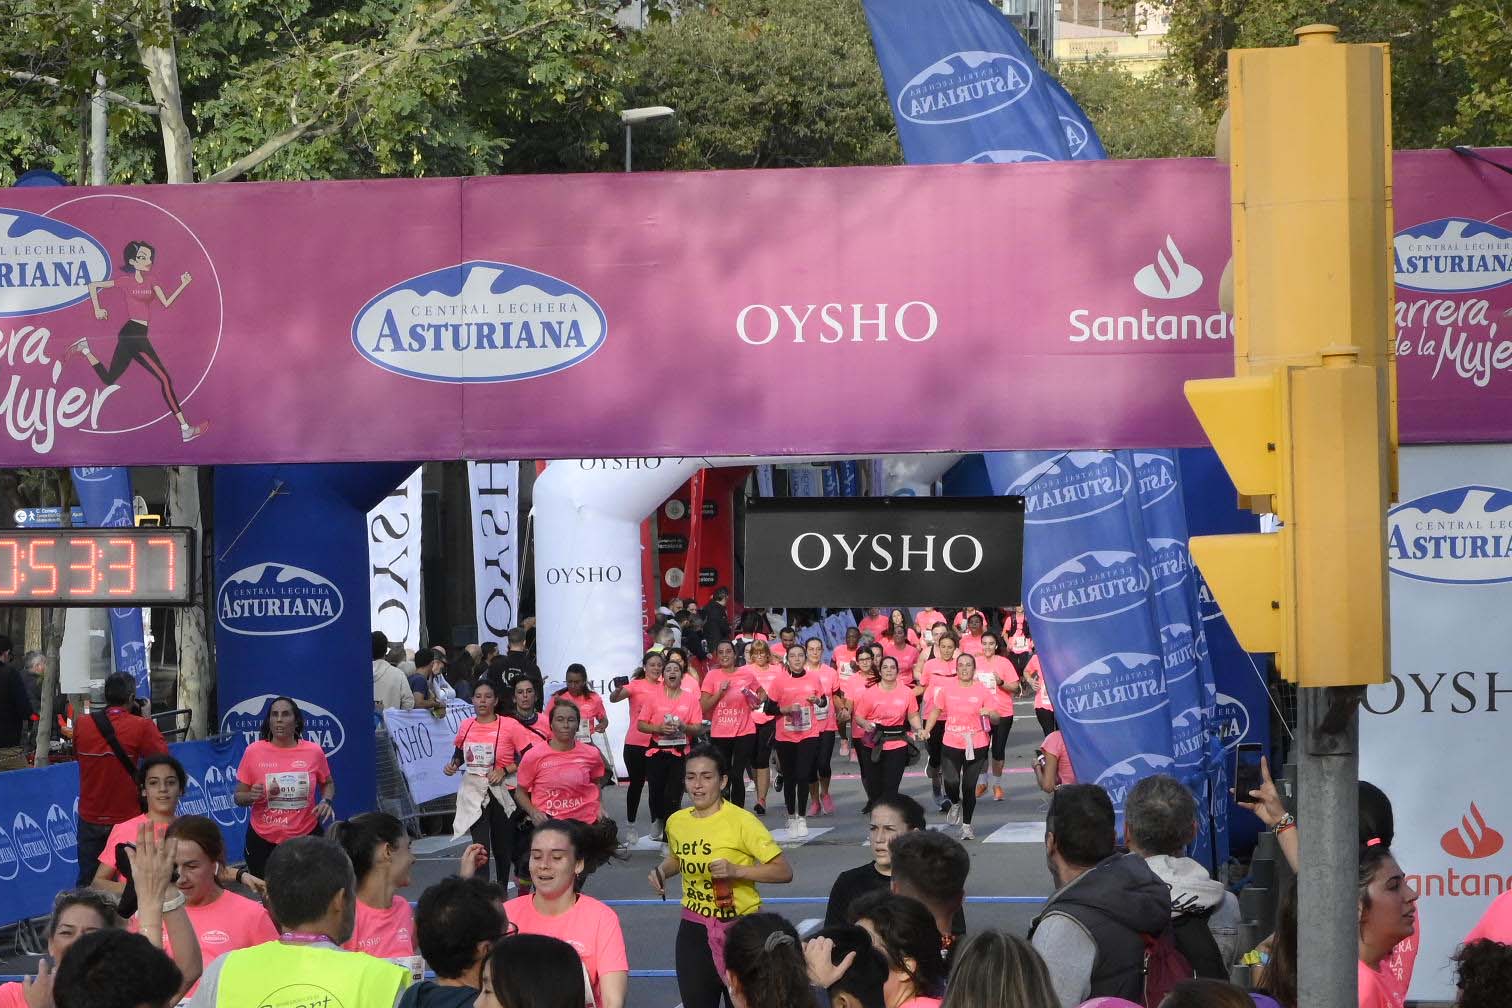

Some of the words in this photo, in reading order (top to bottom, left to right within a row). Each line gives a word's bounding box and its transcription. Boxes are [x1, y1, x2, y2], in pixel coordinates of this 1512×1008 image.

[15, 244, 87, 257] LECHERA
[1408, 242, 1458, 252] CENTRAL
[411, 304, 489, 318] CENTRAL
[498, 301, 579, 315] LECHERA
[1395, 298, 1490, 328] arrera
[372, 307, 588, 354] ASTURIANA
[736, 300, 938, 346] OYSHO
[1418, 327, 1436, 356] la
[1416, 520, 1482, 531] CENTRAL
[790, 532, 983, 574] OYSHO
[546, 565, 622, 585] OYSHO
[234, 586, 276, 596] CENTRAL
[281, 586, 329, 596] LECHERA
[221, 589, 334, 620] ASTURIANA
[675, 838, 712, 856] Let's
[1405, 868, 1512, 897] antan
[686, 887, 714, 903] Bet
[686, 899, 737, 920] World
